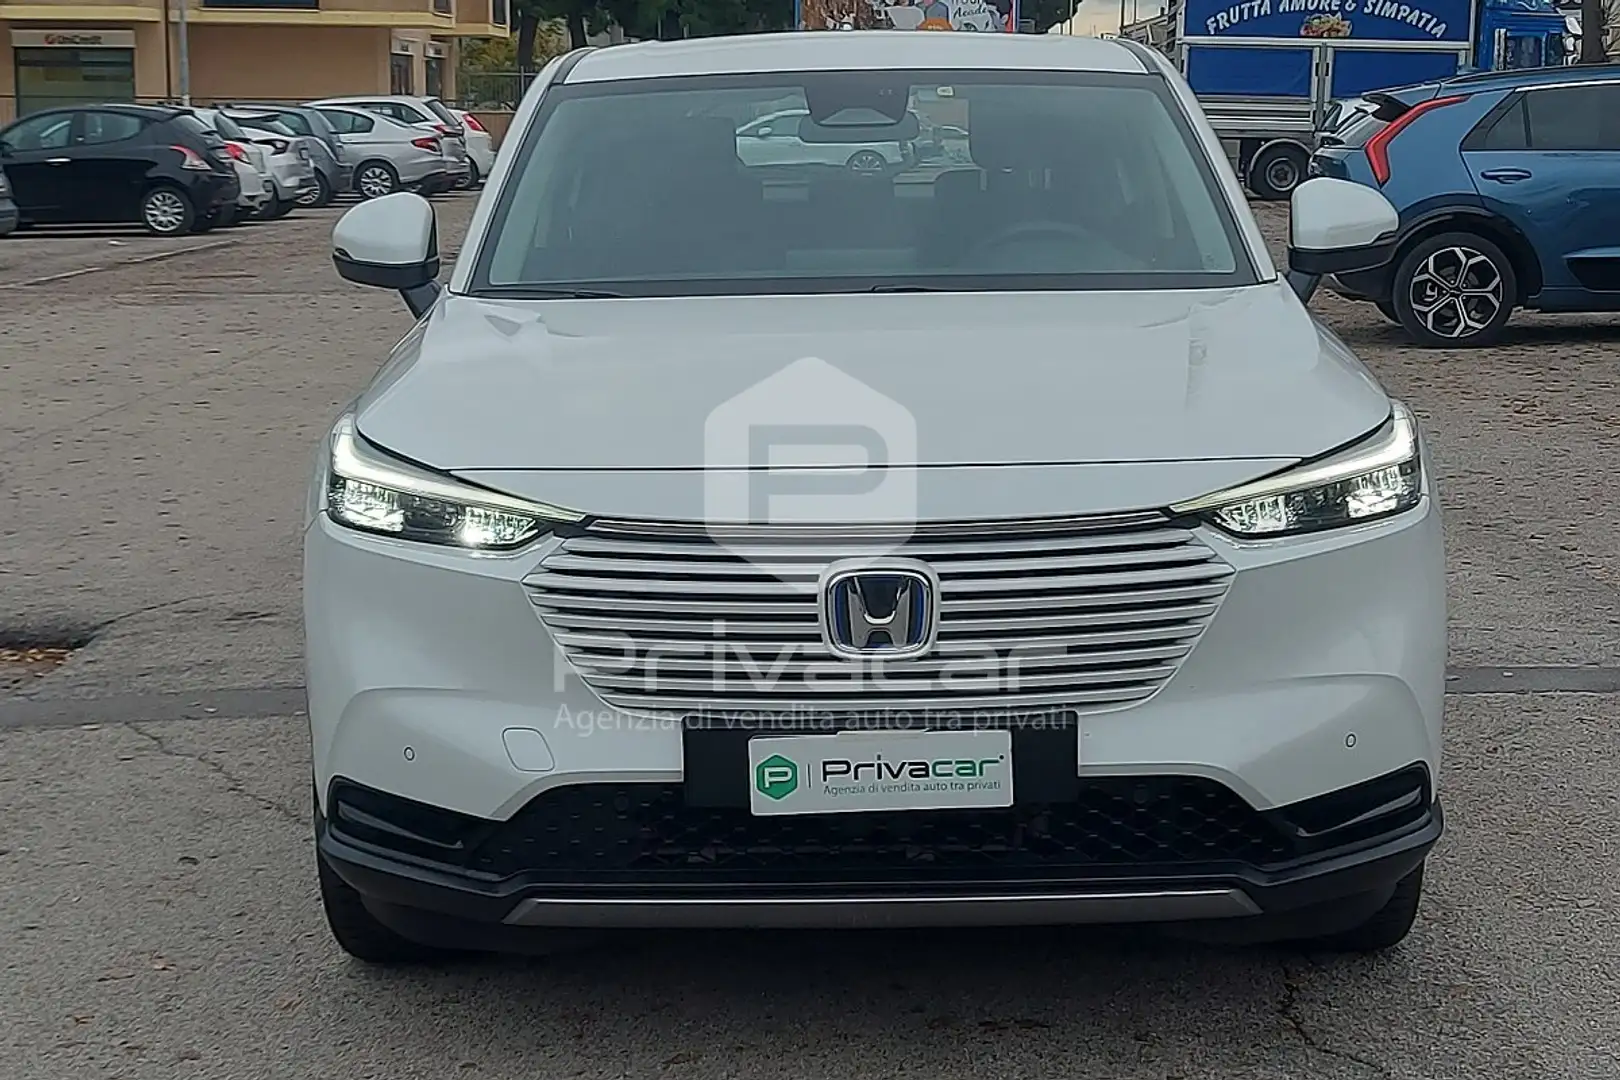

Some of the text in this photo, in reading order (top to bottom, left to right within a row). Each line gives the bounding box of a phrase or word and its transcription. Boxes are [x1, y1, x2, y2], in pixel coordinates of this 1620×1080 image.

[1206, 0, 1271, 35] FRUTTA
[1279, 0, 1341, 13] AMORE
[1364, 0, 1447, 38] SIMPATIA
[821, 753, 1002, 783] Privacar
[823, 780, 1001, 797] Agenzia di vendita auto tra privati
